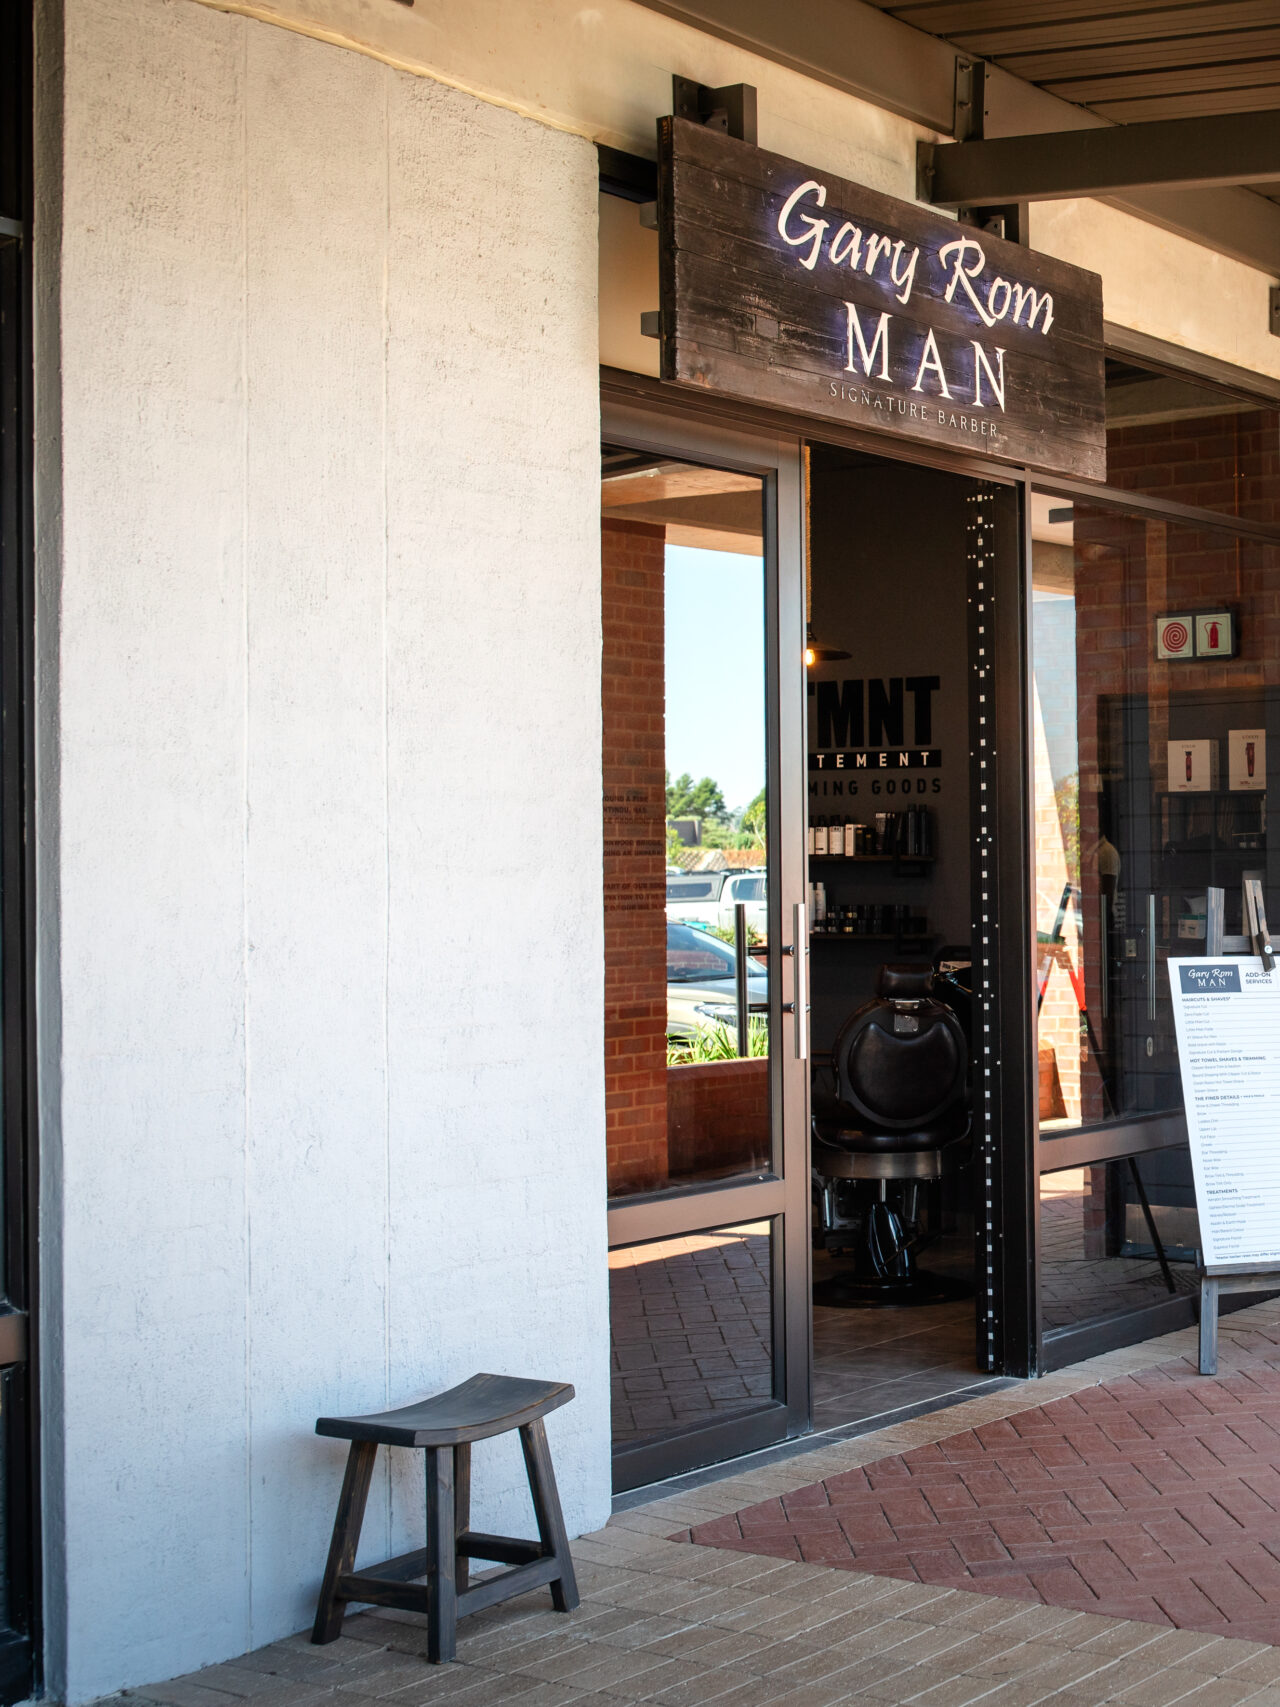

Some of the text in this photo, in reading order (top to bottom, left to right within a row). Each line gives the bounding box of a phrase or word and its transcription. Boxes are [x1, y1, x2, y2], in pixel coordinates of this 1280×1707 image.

[777, 180, 1054, 335] Gary Rom
[843, 301, 1007, 413] MAN
[829, 382, 998, 438] SIGNATURE BARBER
[871, 777, 942, 795] GOODS
[1188, 968, 1233, 979] Gary Rom
[1197, 978, 1226, 987] MAN
